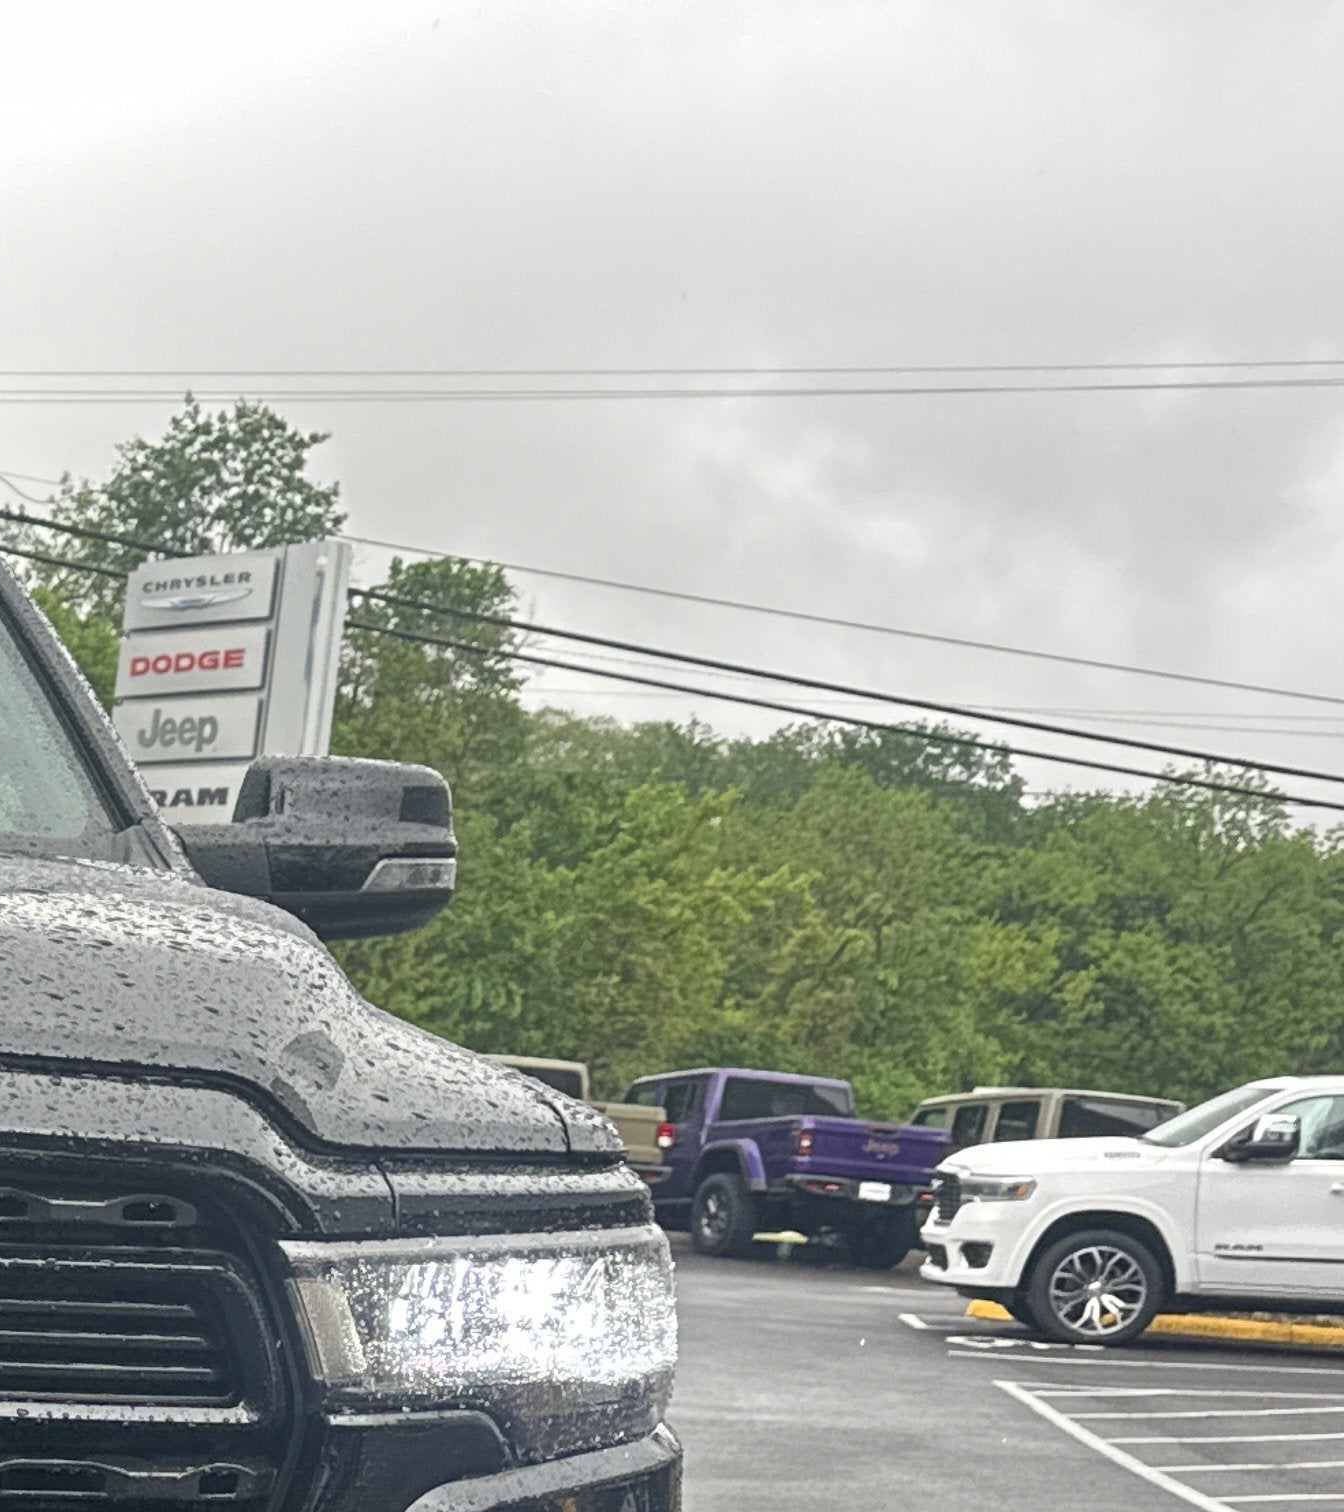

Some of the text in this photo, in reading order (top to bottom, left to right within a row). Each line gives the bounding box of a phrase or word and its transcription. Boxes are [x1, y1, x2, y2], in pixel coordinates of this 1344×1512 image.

[142, 571, 252, 593] CHRYSLER
[130, 648, 245, 677] DODGE
[137, 708, 218, 753] Jeep
[150, 787, 229, 807] RAM
